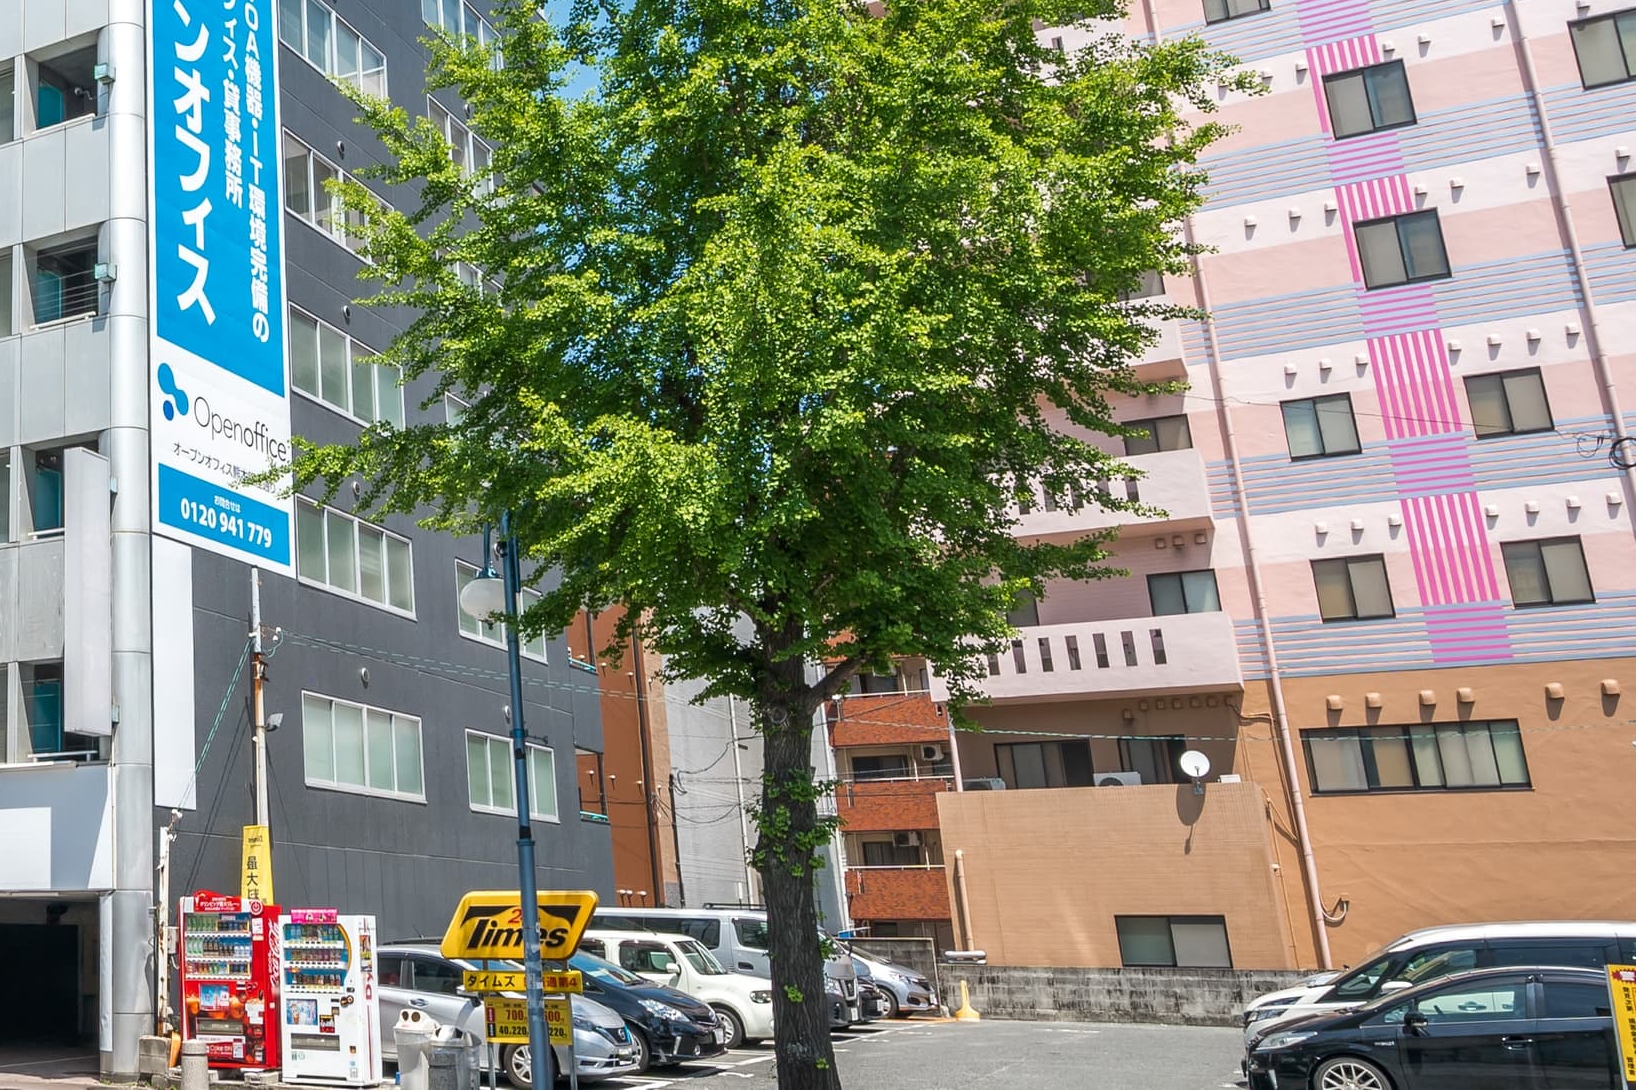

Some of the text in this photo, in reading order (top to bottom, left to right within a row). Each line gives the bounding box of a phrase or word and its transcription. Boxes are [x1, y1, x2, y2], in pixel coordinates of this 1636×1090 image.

[194, 396, 287, 461] Openoffice
[180, 498, 272, 548] 0120 941 779
[467, 975, 516, 988] タイムズ
